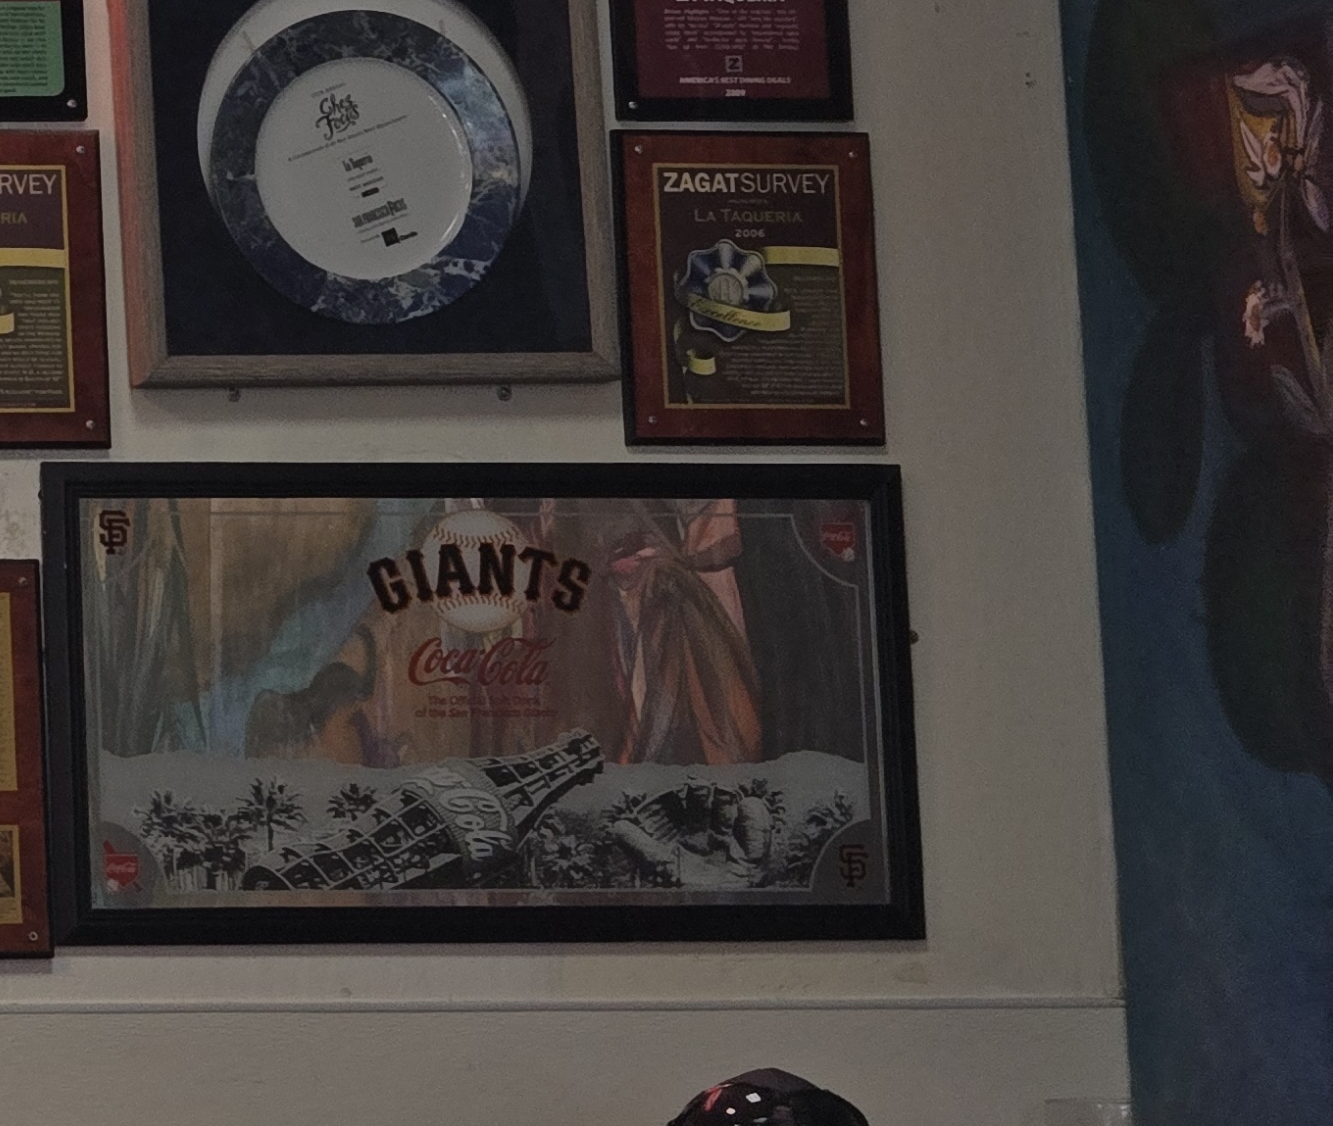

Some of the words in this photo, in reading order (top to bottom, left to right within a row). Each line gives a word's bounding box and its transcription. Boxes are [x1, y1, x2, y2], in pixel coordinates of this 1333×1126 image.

[662, 171, 830, 195] ZAGATSURVEY
[694, 208, 718, 222] LA
[720, 208, 803, 223] TAQUERIA
[734, 228, 766, 238] 2006
[367, 541, 592, 614] GIANTS
[408, 636, 557, 686] Coca-Cola
